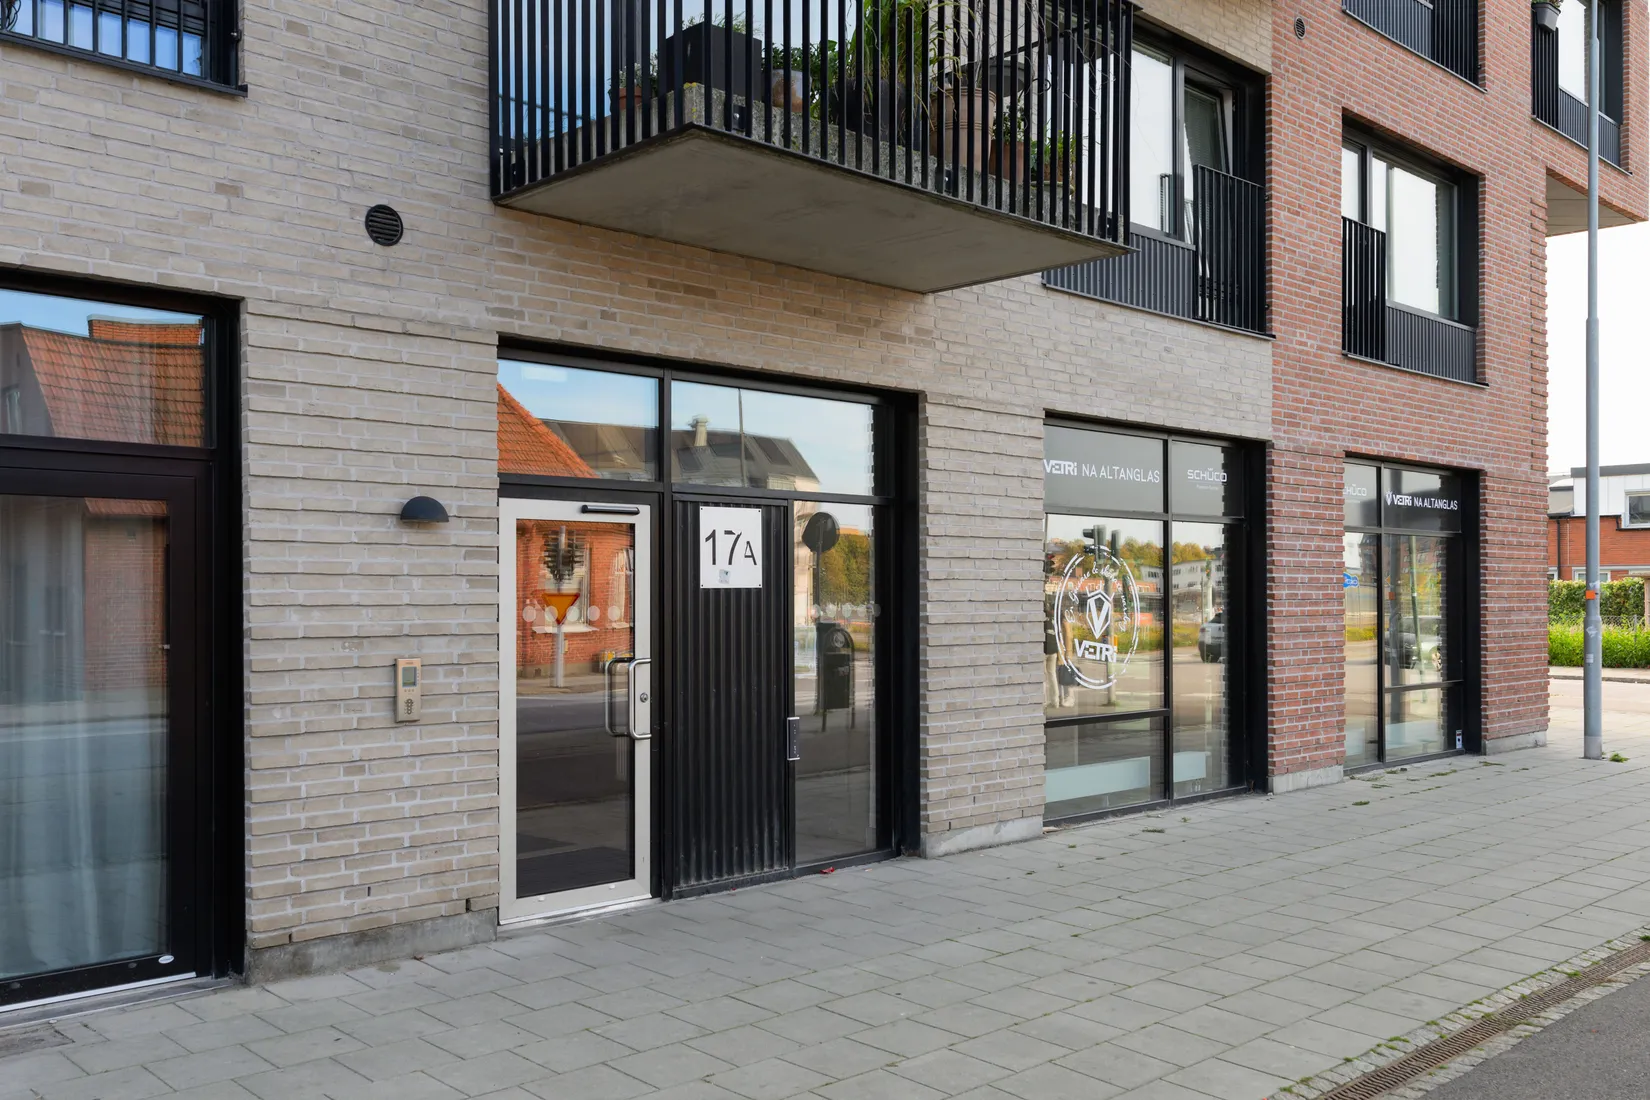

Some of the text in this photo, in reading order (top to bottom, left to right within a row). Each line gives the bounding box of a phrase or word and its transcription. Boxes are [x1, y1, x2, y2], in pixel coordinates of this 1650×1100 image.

[1082, 464, 1098, 478] NA
[1099, 465, 1160, 483] ALTANGLAS
[1187, 467, 1228, 482] SCHÜCO
[1413, 497, 1423, 507] NA
[1423, 498, 1459, 510] ALTANGLAS
